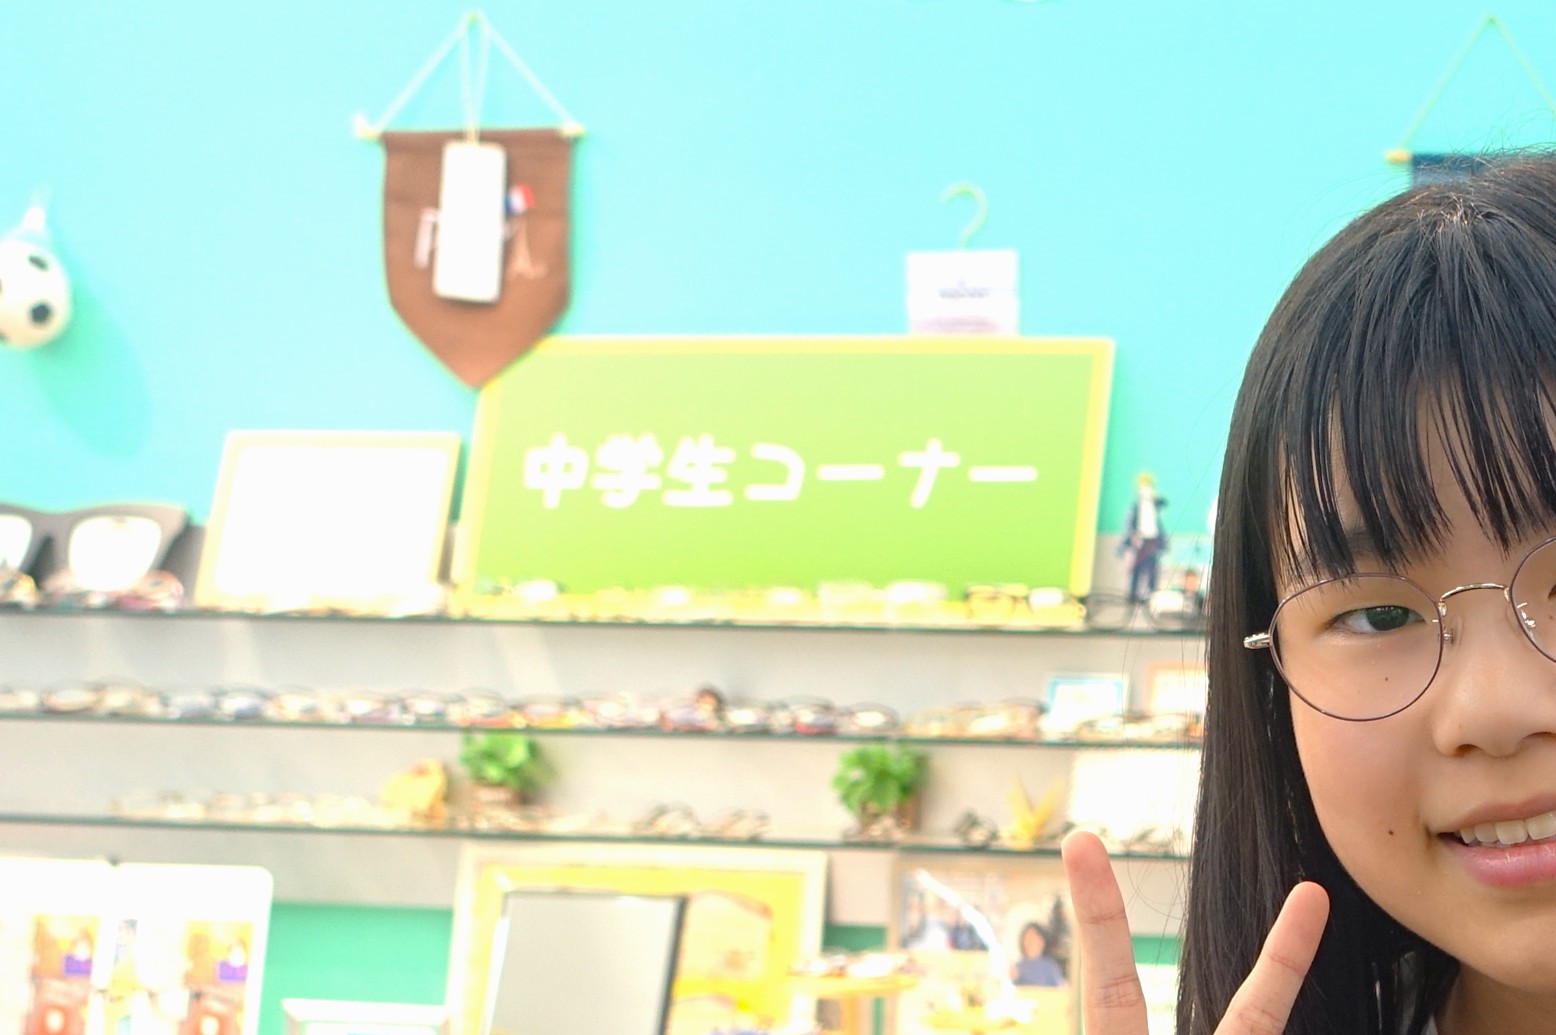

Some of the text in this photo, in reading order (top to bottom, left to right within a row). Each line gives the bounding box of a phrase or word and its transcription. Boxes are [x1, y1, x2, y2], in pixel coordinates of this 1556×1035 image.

[523, 432, 1038, 509] 中学生コーナー
